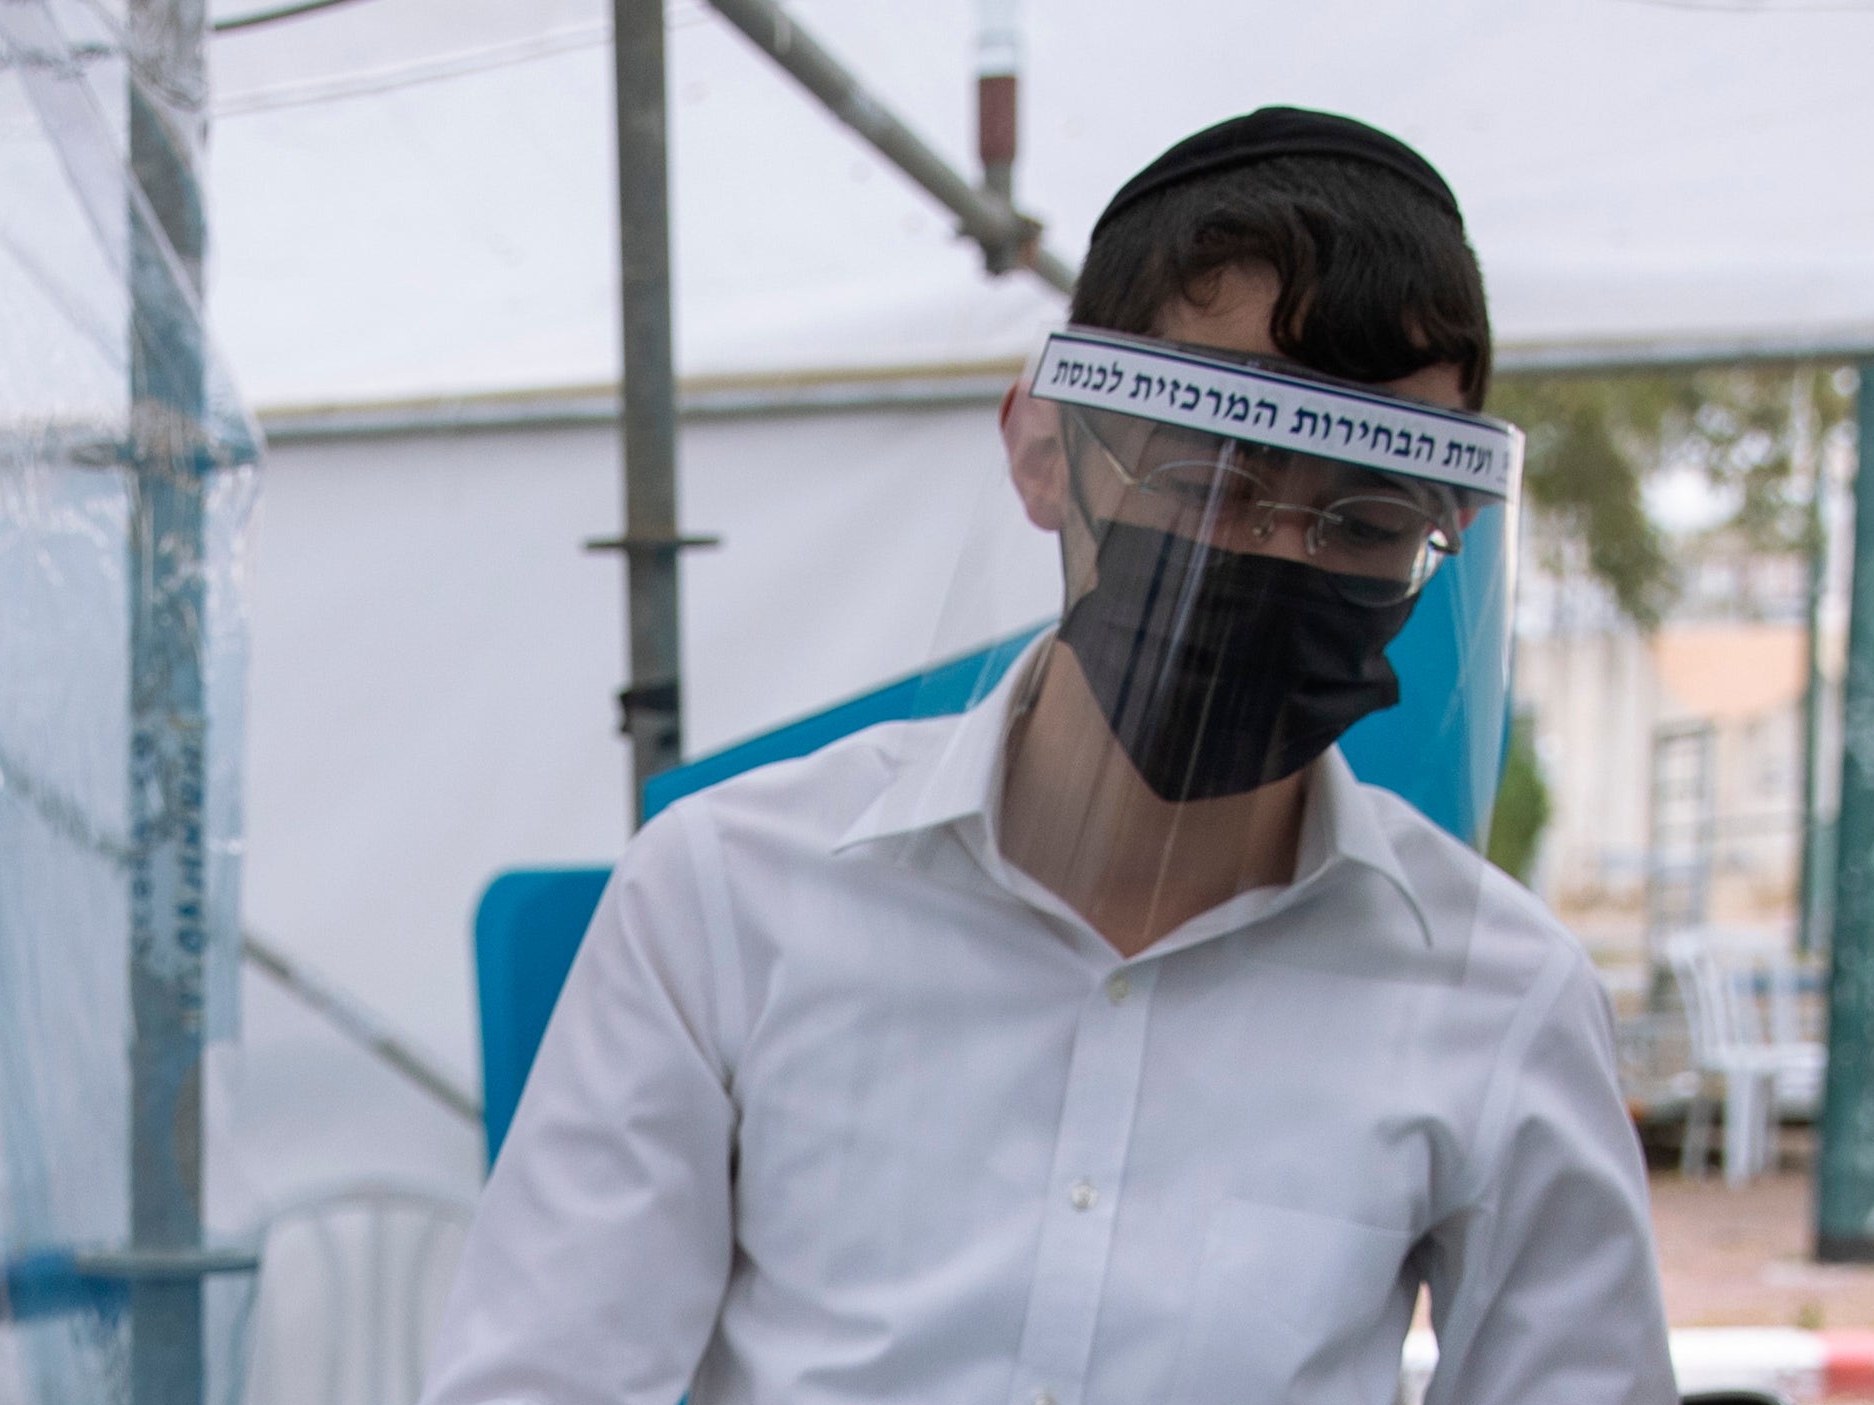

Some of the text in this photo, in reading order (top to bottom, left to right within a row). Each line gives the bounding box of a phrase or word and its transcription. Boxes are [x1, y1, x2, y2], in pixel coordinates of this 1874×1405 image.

[1051, 359, 1494, 476] ועדת הבחירות המרכזית לכנסת
